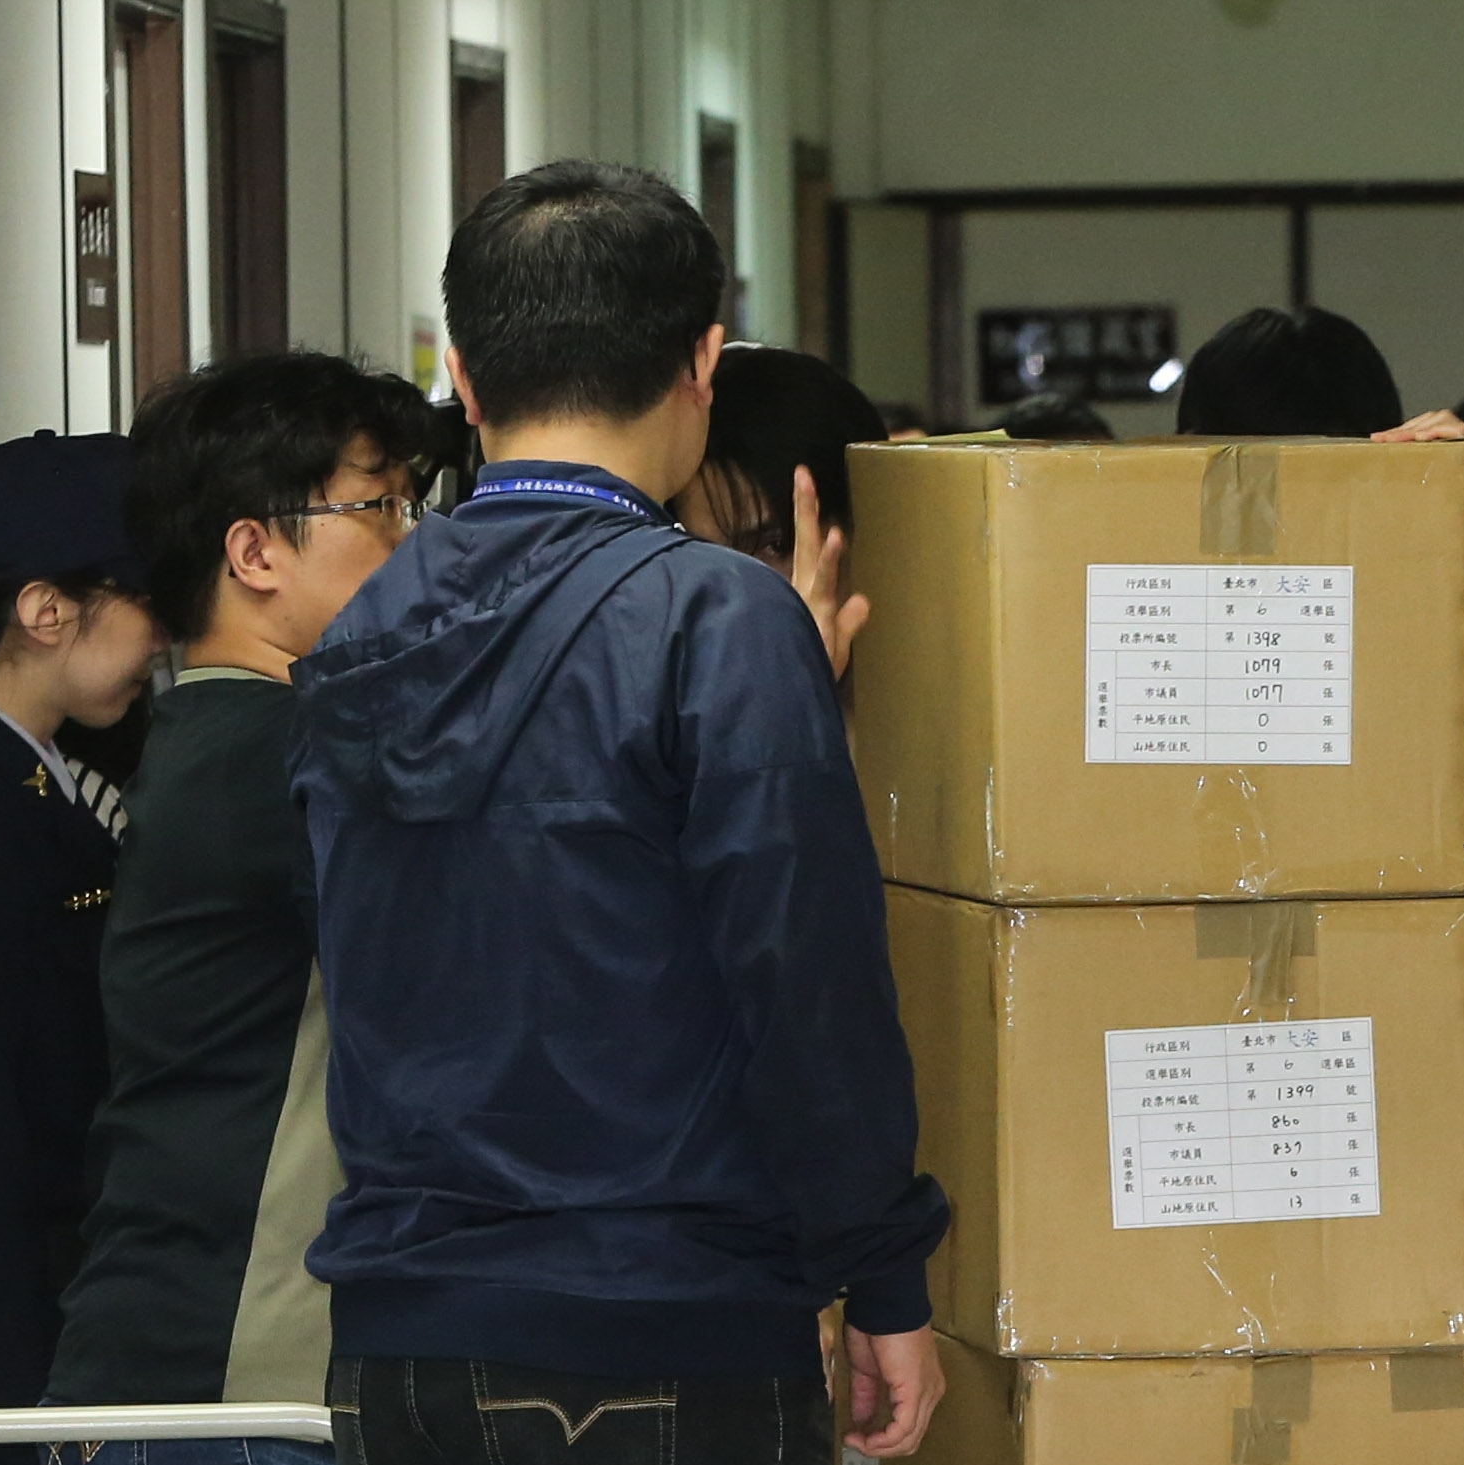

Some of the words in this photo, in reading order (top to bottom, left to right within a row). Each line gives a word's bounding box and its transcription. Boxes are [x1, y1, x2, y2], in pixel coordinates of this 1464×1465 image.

[1125, 577, 1172, 590] 行政區別
[1222, 576, 1258, 590] 臺北市
[1275, 575, 1311, 594] 大安
[1322, 577, 1333, 590] 區
[1125, 604, 1171, 617] 選舉區別
[1225, 603, 1235, 617] 第
[1300, 604, 1336, 617] 選舉區
[1119, 631, 1178, 645] 投票所編號
[1225, 631, 1235, 644] 第
[1246, 630, 1282, 648] 1398
[1323, 632, 1336, 645] 號
[1150, 659, 1173, 672] 市長
[1244, 657, 1281, 675] 1079
[1322, 659, 1334, 672] 張
[1144, 686, 1178, 699] 市議員
[1245, 683, 1284, 704] 1077
[1322, 686, 1334, 699] 張
[1097, 681, 1109, 729] 選舉票數
[1132, 713, 1191, 726] 平地原住民
[1322, 714, 1334, 727] 張
[1132, 740, 1191, 753] 山地原住民
[1322, 741, 1334, 754] 張
[1241, 1033, 1277, 1048] 臺北市
[1341, 1030, 1353, 1043] 區
[1144, 1040, 1191, 1054] 行政區別
[1245, 1061, 1256, 1074] 第
[1320, 1056, 1356, 1071] 選舉區
[1145, 1067, 1192, 1081] 選舉區別
[1247, 1088, 1257, 1102] 第
[1277, 1083, 1315, 1102] 1399
[1345, 1084, 1358, 1096] 號
[1140, 1093, 1201, 1108] 投票所編號
[1346, 1111, 1358, 1123] 張
[1174, 1120, 1197, 1134] 市長
[1347, 1138, 1360, 1151] 張
[1168, 1147, 1202, 1161] 市議員
[1122, 1146, 1135, 1194] 選舉票數
[1348, 1166, 1360, 1178] 張
[1159, 1174, 1218, 1188] 平地原住民
[1289, 1194, 1303, 1209] 13
[1349, 1192, 1361, 1205] 張
[1160, 1201, 1219, 1215] 山地原住民
